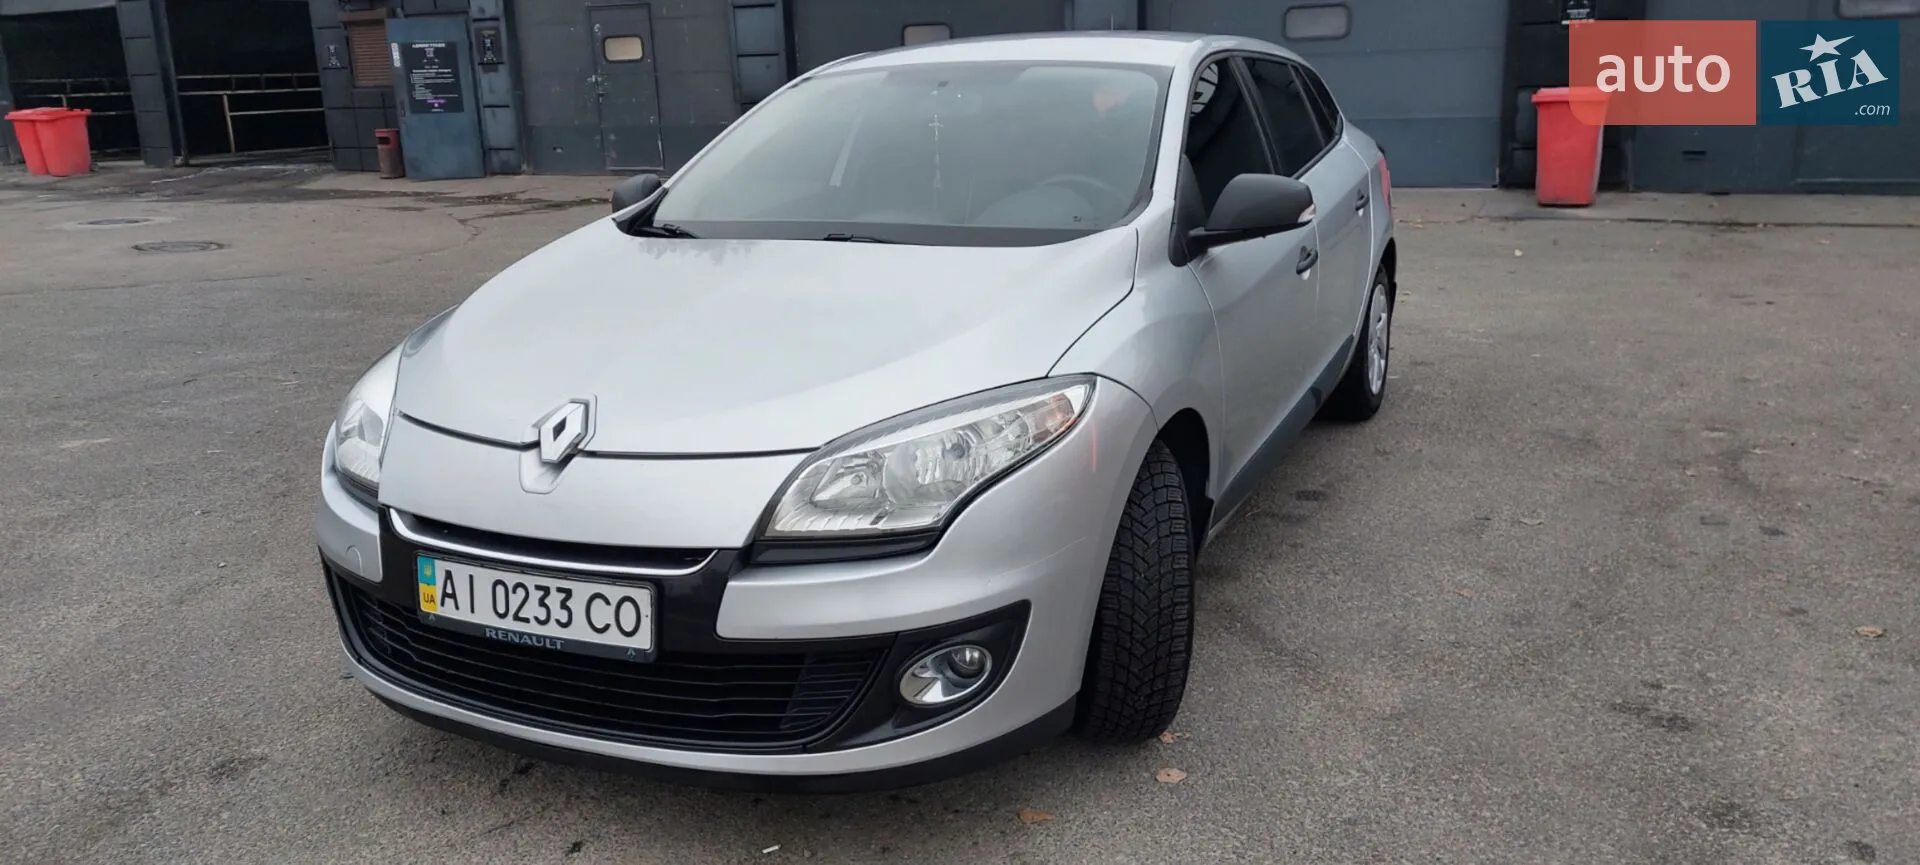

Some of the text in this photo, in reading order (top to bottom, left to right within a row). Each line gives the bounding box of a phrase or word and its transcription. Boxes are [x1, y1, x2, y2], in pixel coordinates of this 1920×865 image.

[423, 592, 436, 605] UA
[440, 569, 641, 638] AI 0233 CO
[485, 628, 564, 649] RENAULT
